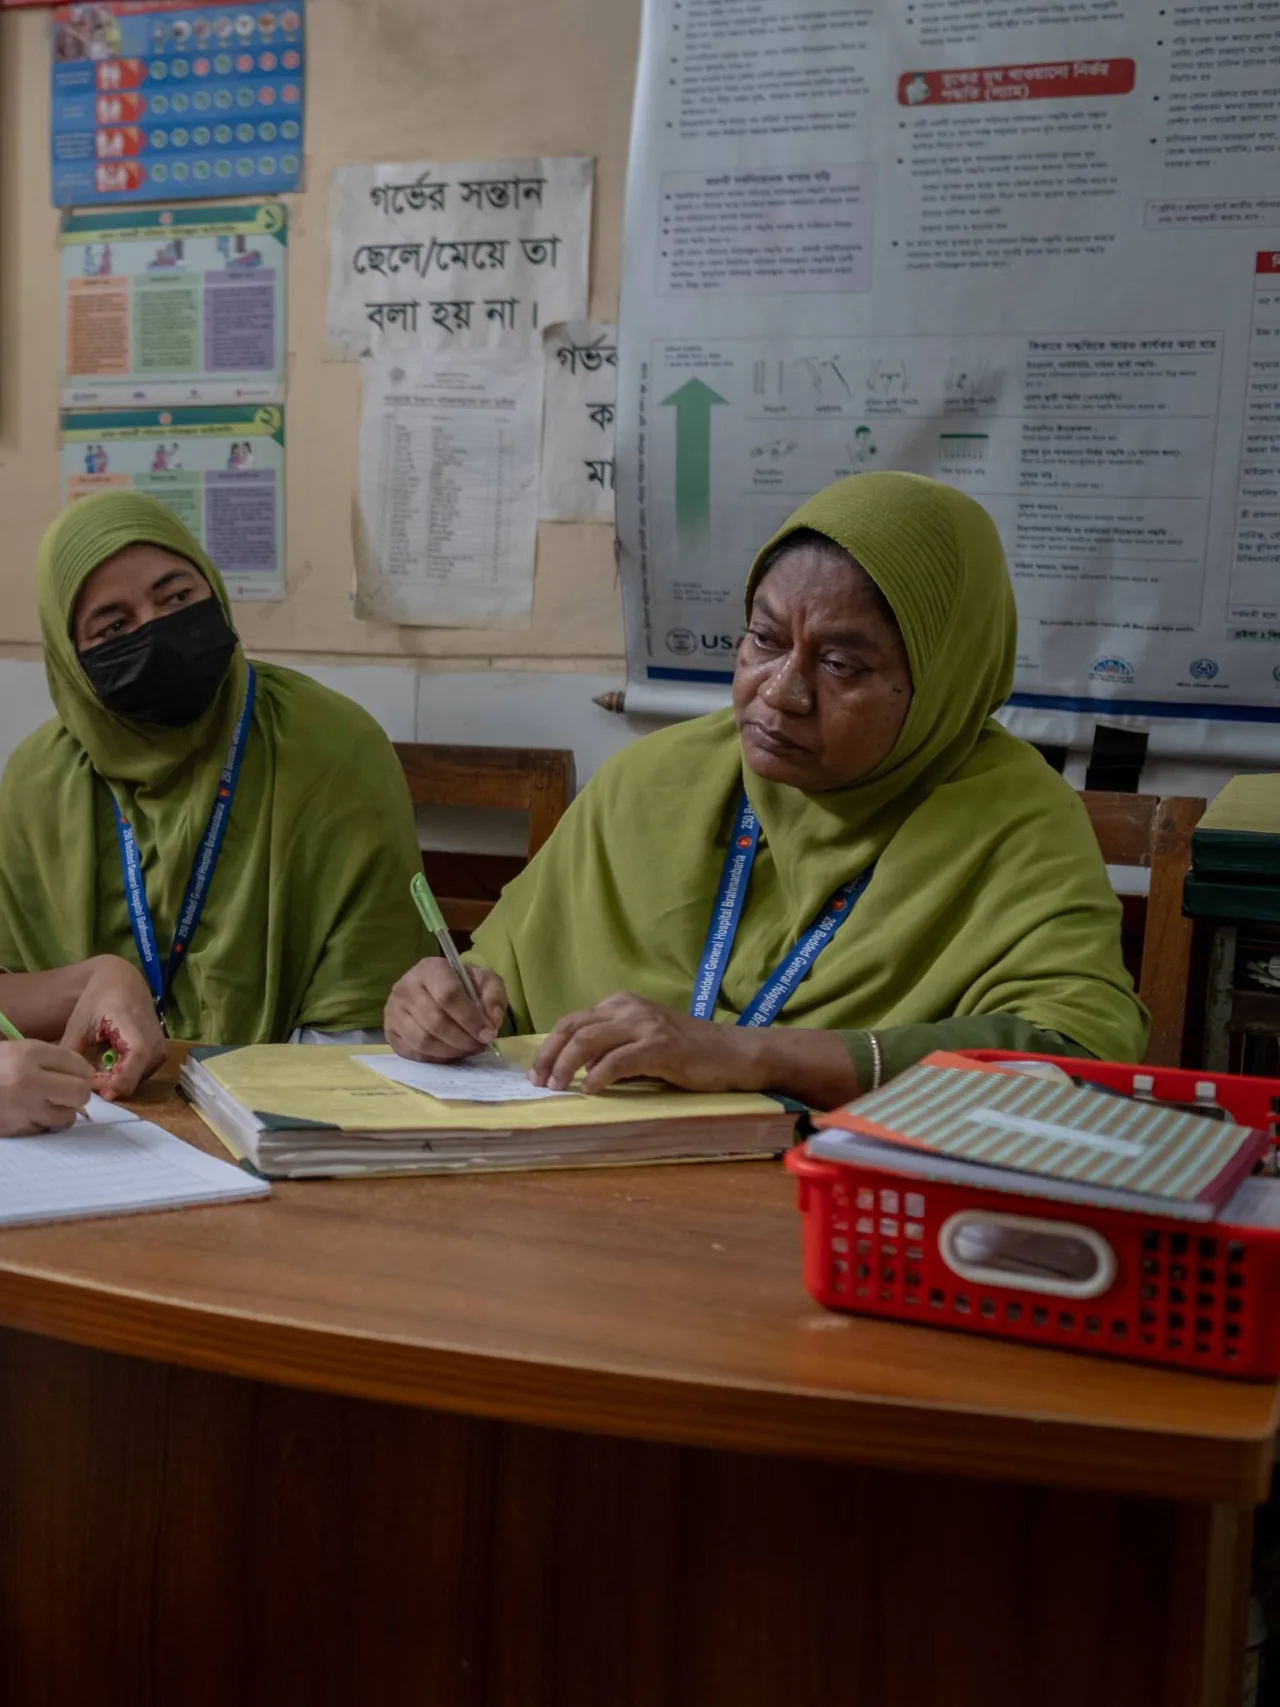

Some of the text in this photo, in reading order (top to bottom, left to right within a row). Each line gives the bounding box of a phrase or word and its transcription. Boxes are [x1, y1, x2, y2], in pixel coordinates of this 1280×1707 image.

[370, 171, 548, 215] গর্ভের সন্তান
[354, 234, 562, 277] ছেলে/মেয়ে তা
[364, 300, 422, 332] বলা
[429, 300, 475, 334] হয়
[483, 297, 523, 330] না
[741, 813, 755, 830] 250
[197, 846, 214, 874] Hospital
[122, 828, 153, 962] 250 Bedded General Hospital Brahmanbaria
[190, 873, 205, 899] General
[182, 898, 197, 925] Bedded
[817, 913, 836, 933] 250
[178, 924, 188, 937] 250
[693, 852, 746, 1018] 250 Bedded General Hospital Brahmanbaria
[798, 927, 826, 959] Bedded
[779, 954, 807, 986] General
[754, 979, 788, 1016] Hospital
